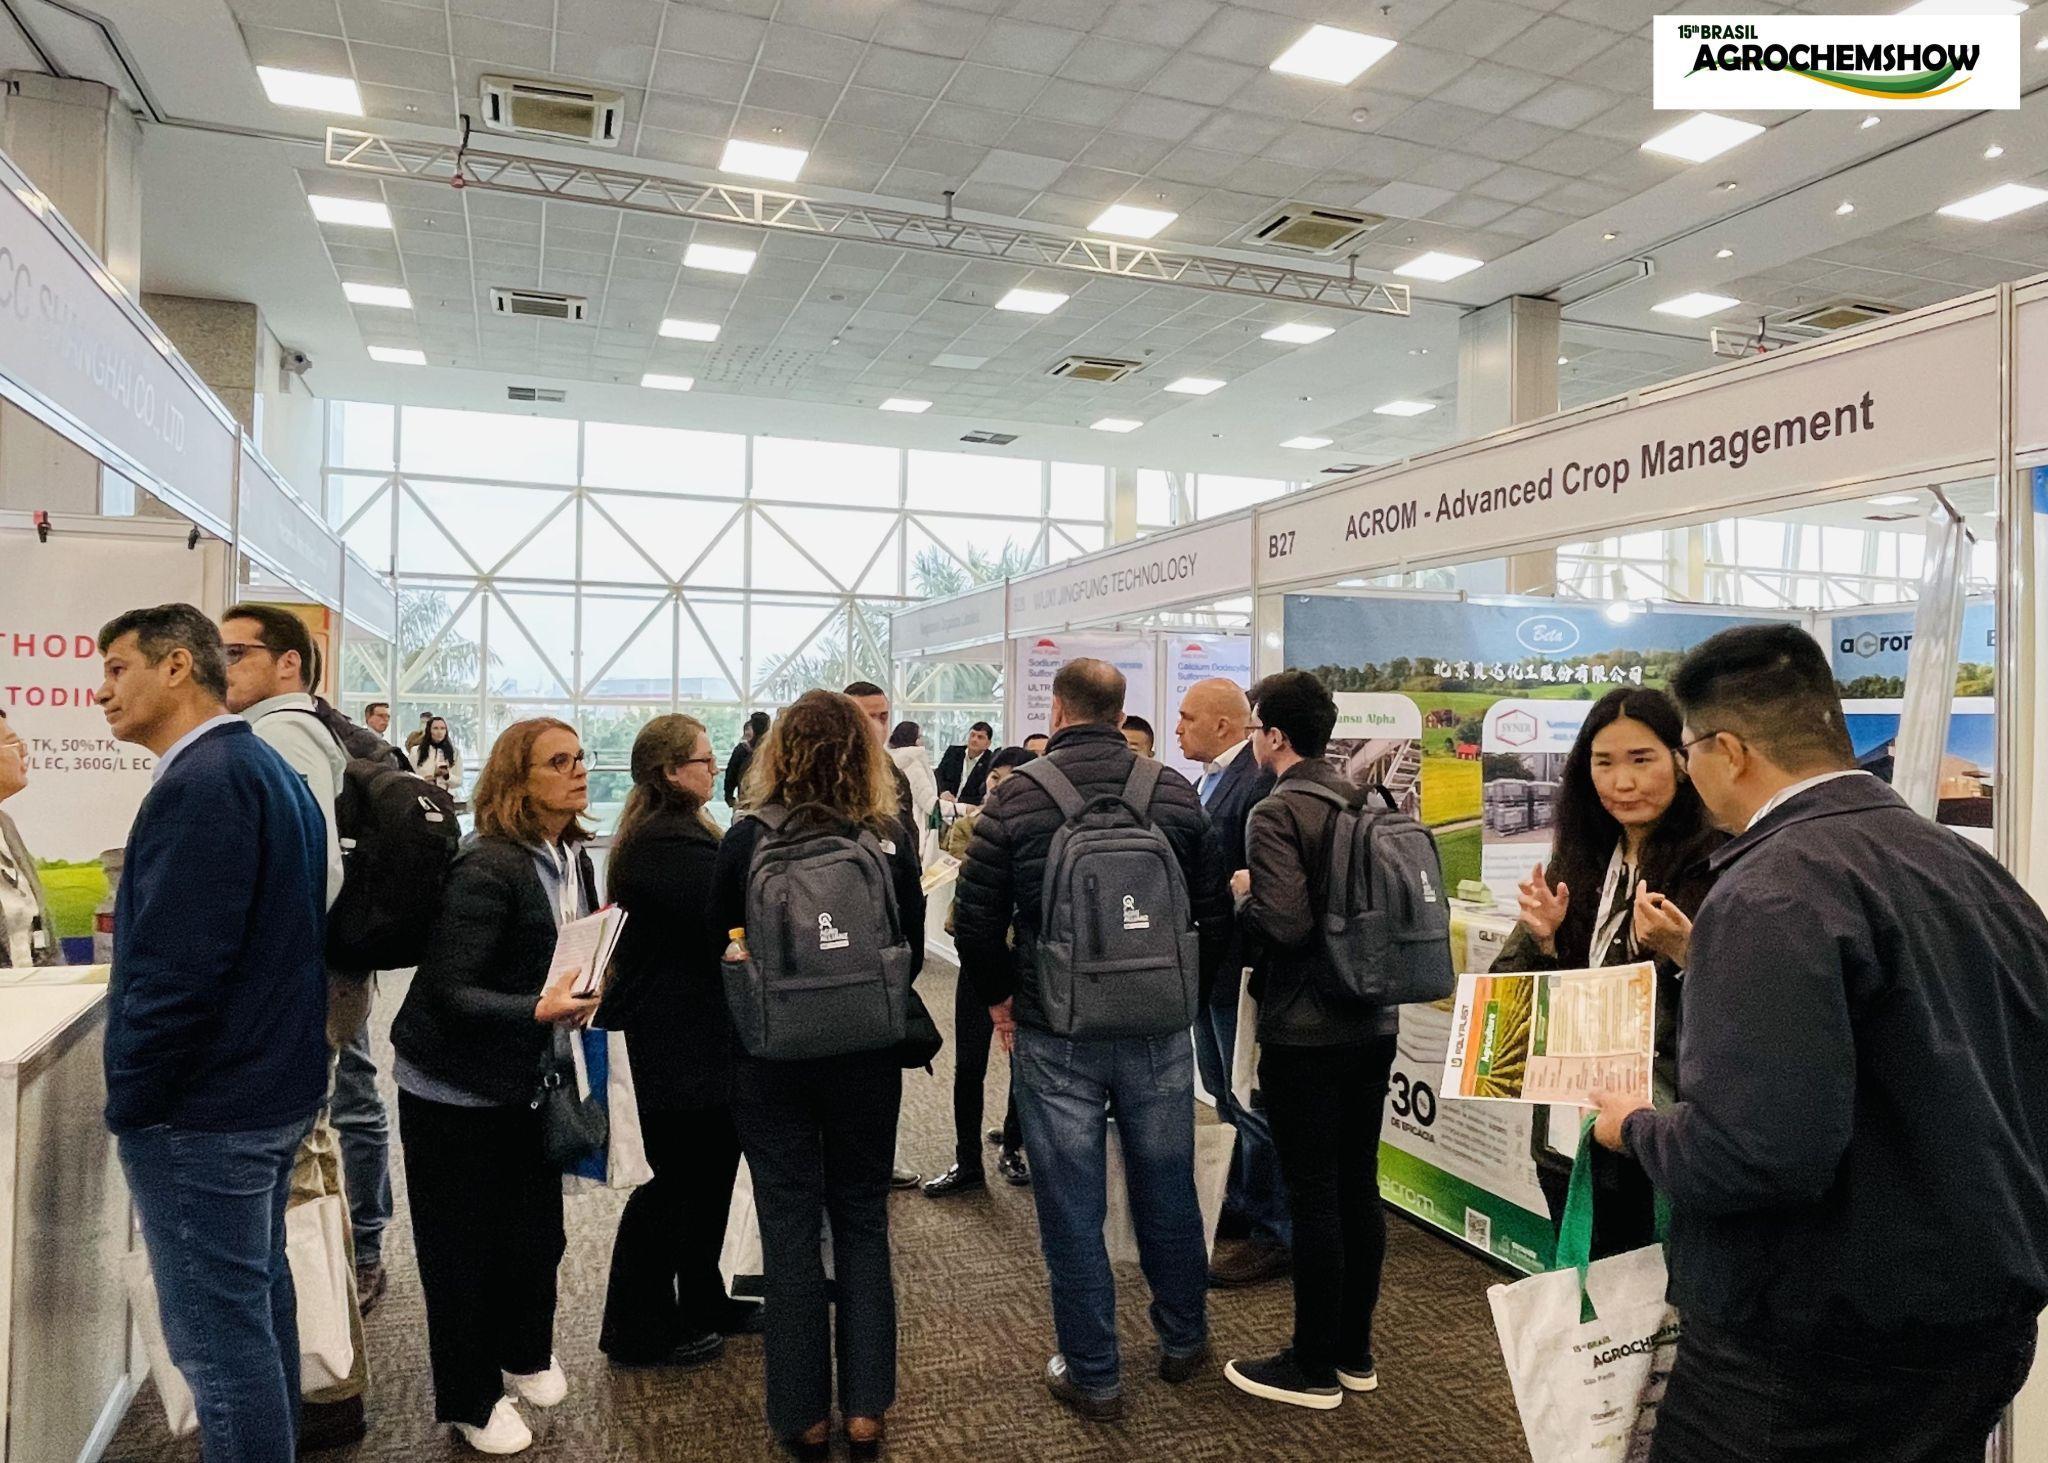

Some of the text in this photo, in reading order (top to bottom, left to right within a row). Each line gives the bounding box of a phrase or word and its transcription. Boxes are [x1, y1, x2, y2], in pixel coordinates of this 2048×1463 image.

[1269, 531, 1296, 558] B27
[1345, 500, 1416, 541] ACROM
[1437, 468, 1553, 523] Advanced
[1562, 458, 1630, 494] Crop
[1641, 391, 1874, 479] Management
[1112, 552, 1198, 593] TECHNOLOGY
[1337, 715, 1363, 725] ansu
[33, 739, 57, 754] TK,
[45, 757, 69, 773] EC,
[73, 757, 127, 773] 360G/L
[133, 758, 152, 770] EC
[1481, 1012, 1497, 1063] Agriculture
[1381, 1174, 1435, 1216] acrom
